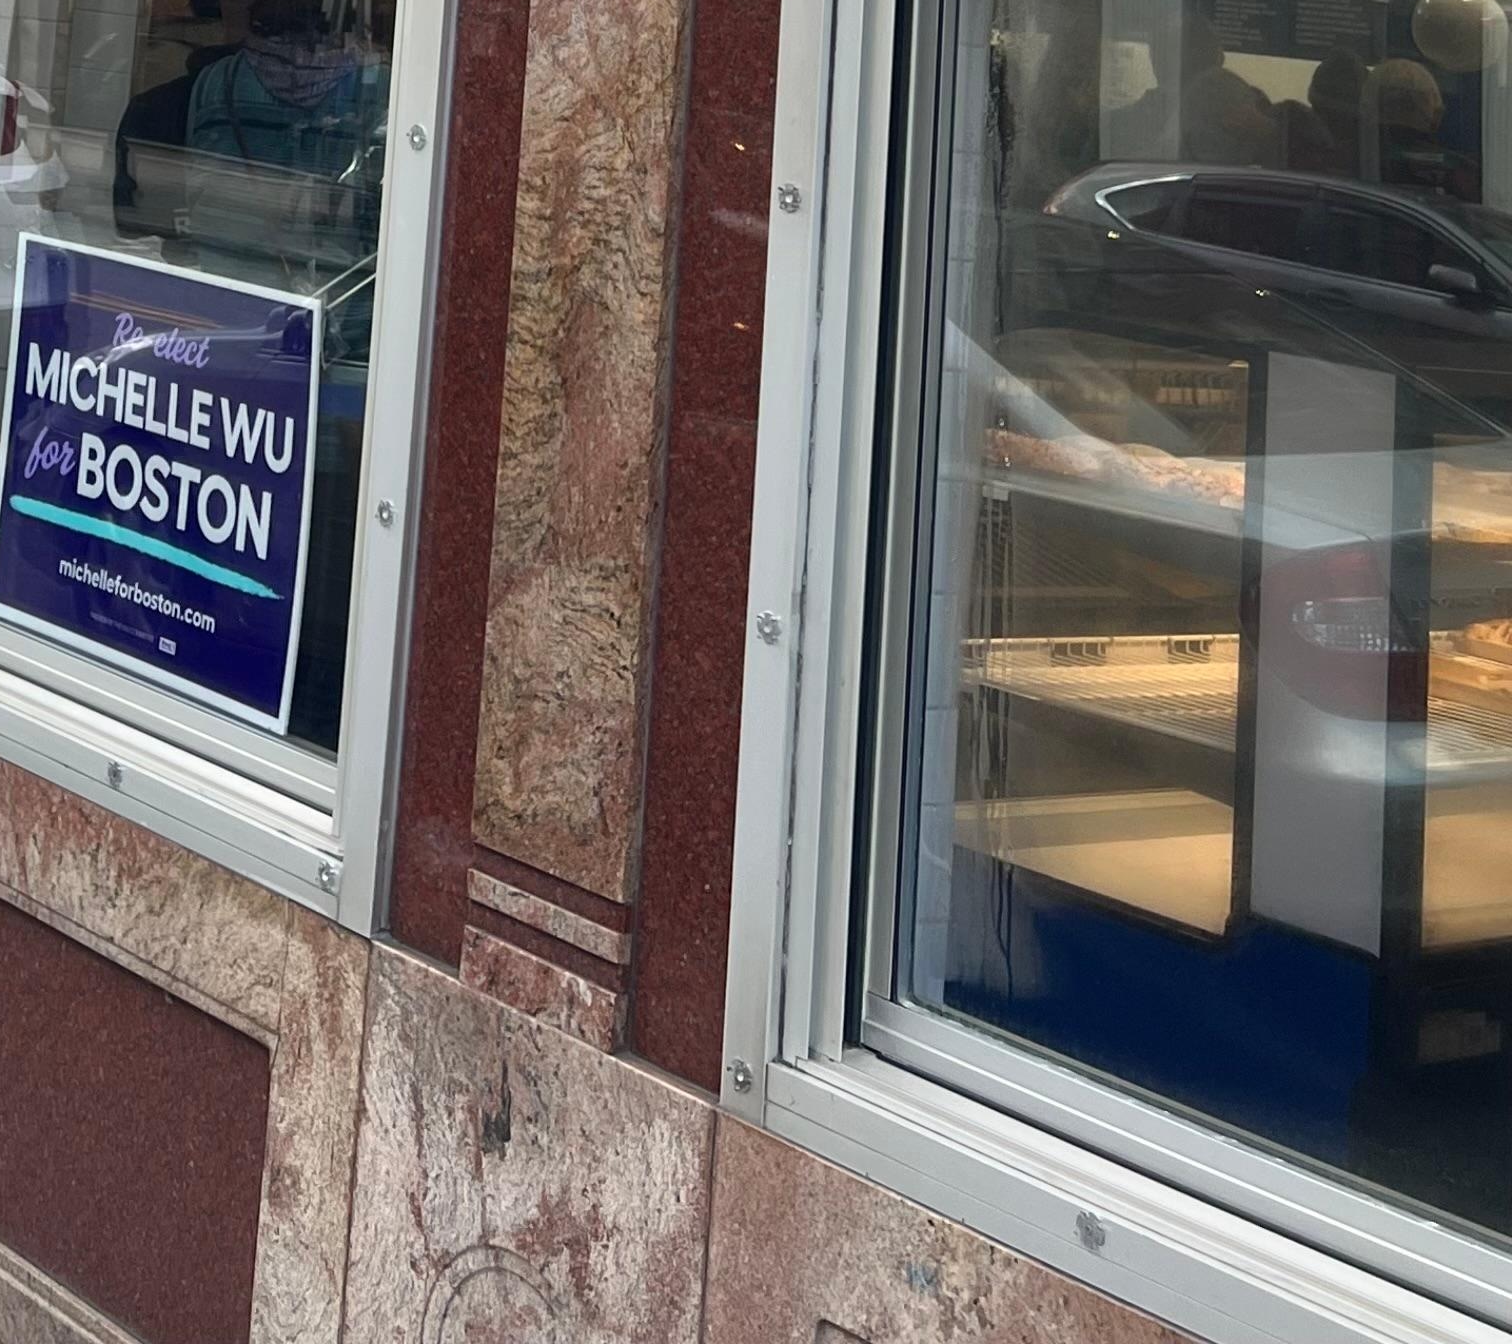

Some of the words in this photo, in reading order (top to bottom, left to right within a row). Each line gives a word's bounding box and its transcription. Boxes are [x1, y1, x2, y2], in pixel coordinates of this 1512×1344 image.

[112, 312, 210, 369] Reelect
[25, 341, 214, 450] MICHELLE
[220, 396, 295, 474] WU
[23, 425, 76, 480] for
[76, 431, 273, 561] BOSTON
[58, 557, 217, 635] michelleforboston.com
